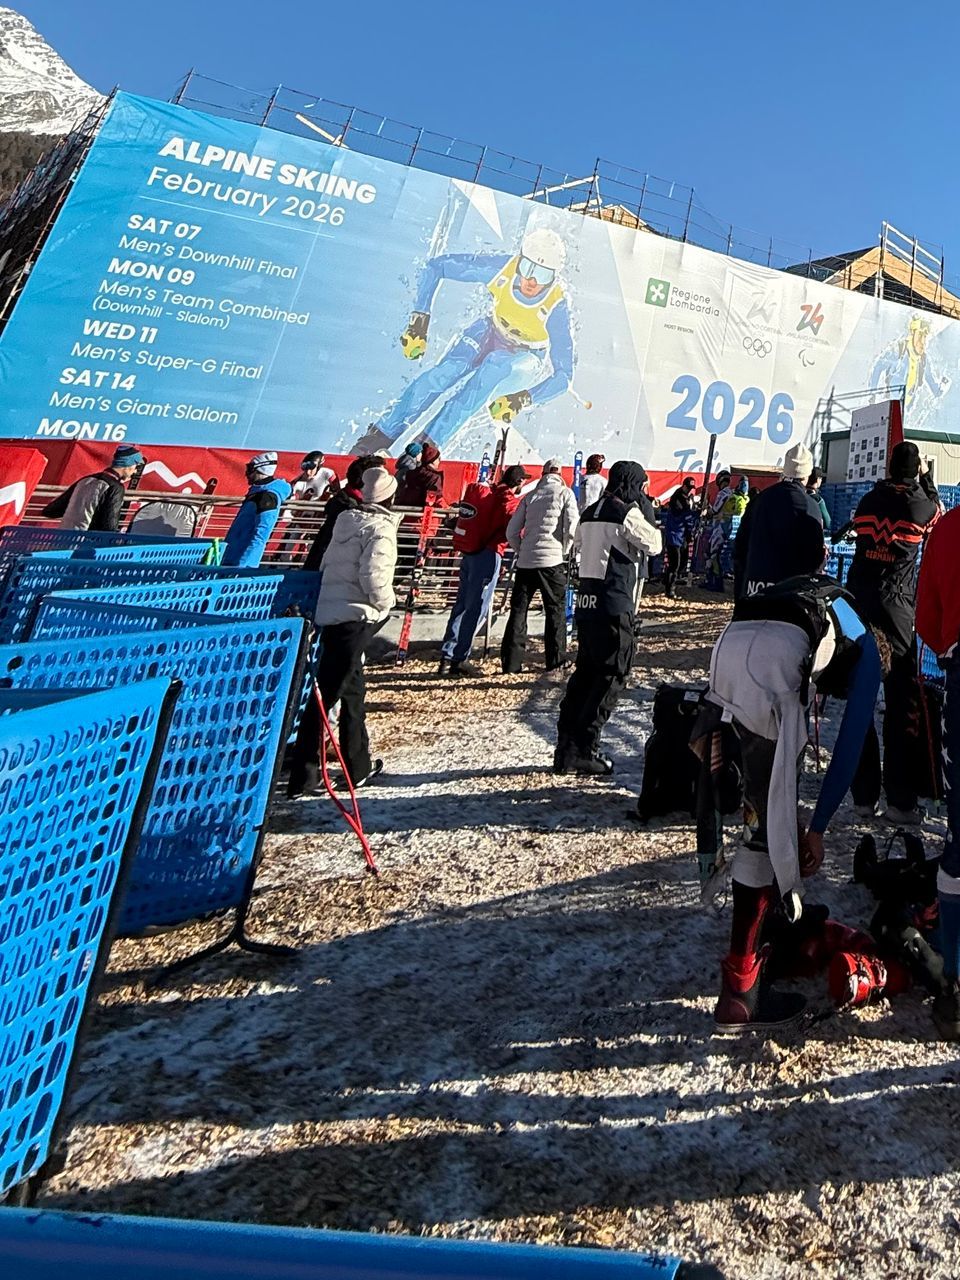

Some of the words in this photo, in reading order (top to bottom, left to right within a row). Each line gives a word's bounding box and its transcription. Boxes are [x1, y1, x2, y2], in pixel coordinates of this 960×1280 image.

[158, 137, 277, 180] ALPINE
[277, 164, 377, 204] SKIING
[147, 166, 278, 217] February
[282, 196, 345, 226] 2026
[127, 214, 173, 235] SAT
[174, 223, 202, 241] 07
[107, 257, 165, 281] MON
[167, 268, 196, 286] 09
[118, 234, 176, 257] Men's
[178, 245, 255, 273] Downhill
[257, 260, 298, 280] Final
[98, 279, 157, 302] Men's
[162, 289, 215, 311] Team
[218, 299, 310, 326] Combined
[669, 296, 720, 318] Lombardia
[671, 286, 711, 305] Regione
[92, 295, 163, 318] (Downhill
[176, 310, 231, 330] Slalom)
[82, 319, 136, 341] WED
[139, 326, 158, 344] 11
[70, 341, 132, 363] Men's
[135, 350, 217, 373] Super-G
[219, 360, 264, 380] Final
[59, 367, 110, 388] SAT
[110, 373, 137, 391] 14
[49, 391, 112, 412] Men's
[116, 398, 171, 419] Giant
[174, 404, 239, 425] Slalom
[666, 374, 795, 445] 2026
[36, 418, 99, 441] MON
[101, 423, 128, 442] 16
[865, 549, 897, 564] GERMANY
[577, 593, 598, 610] NOR
